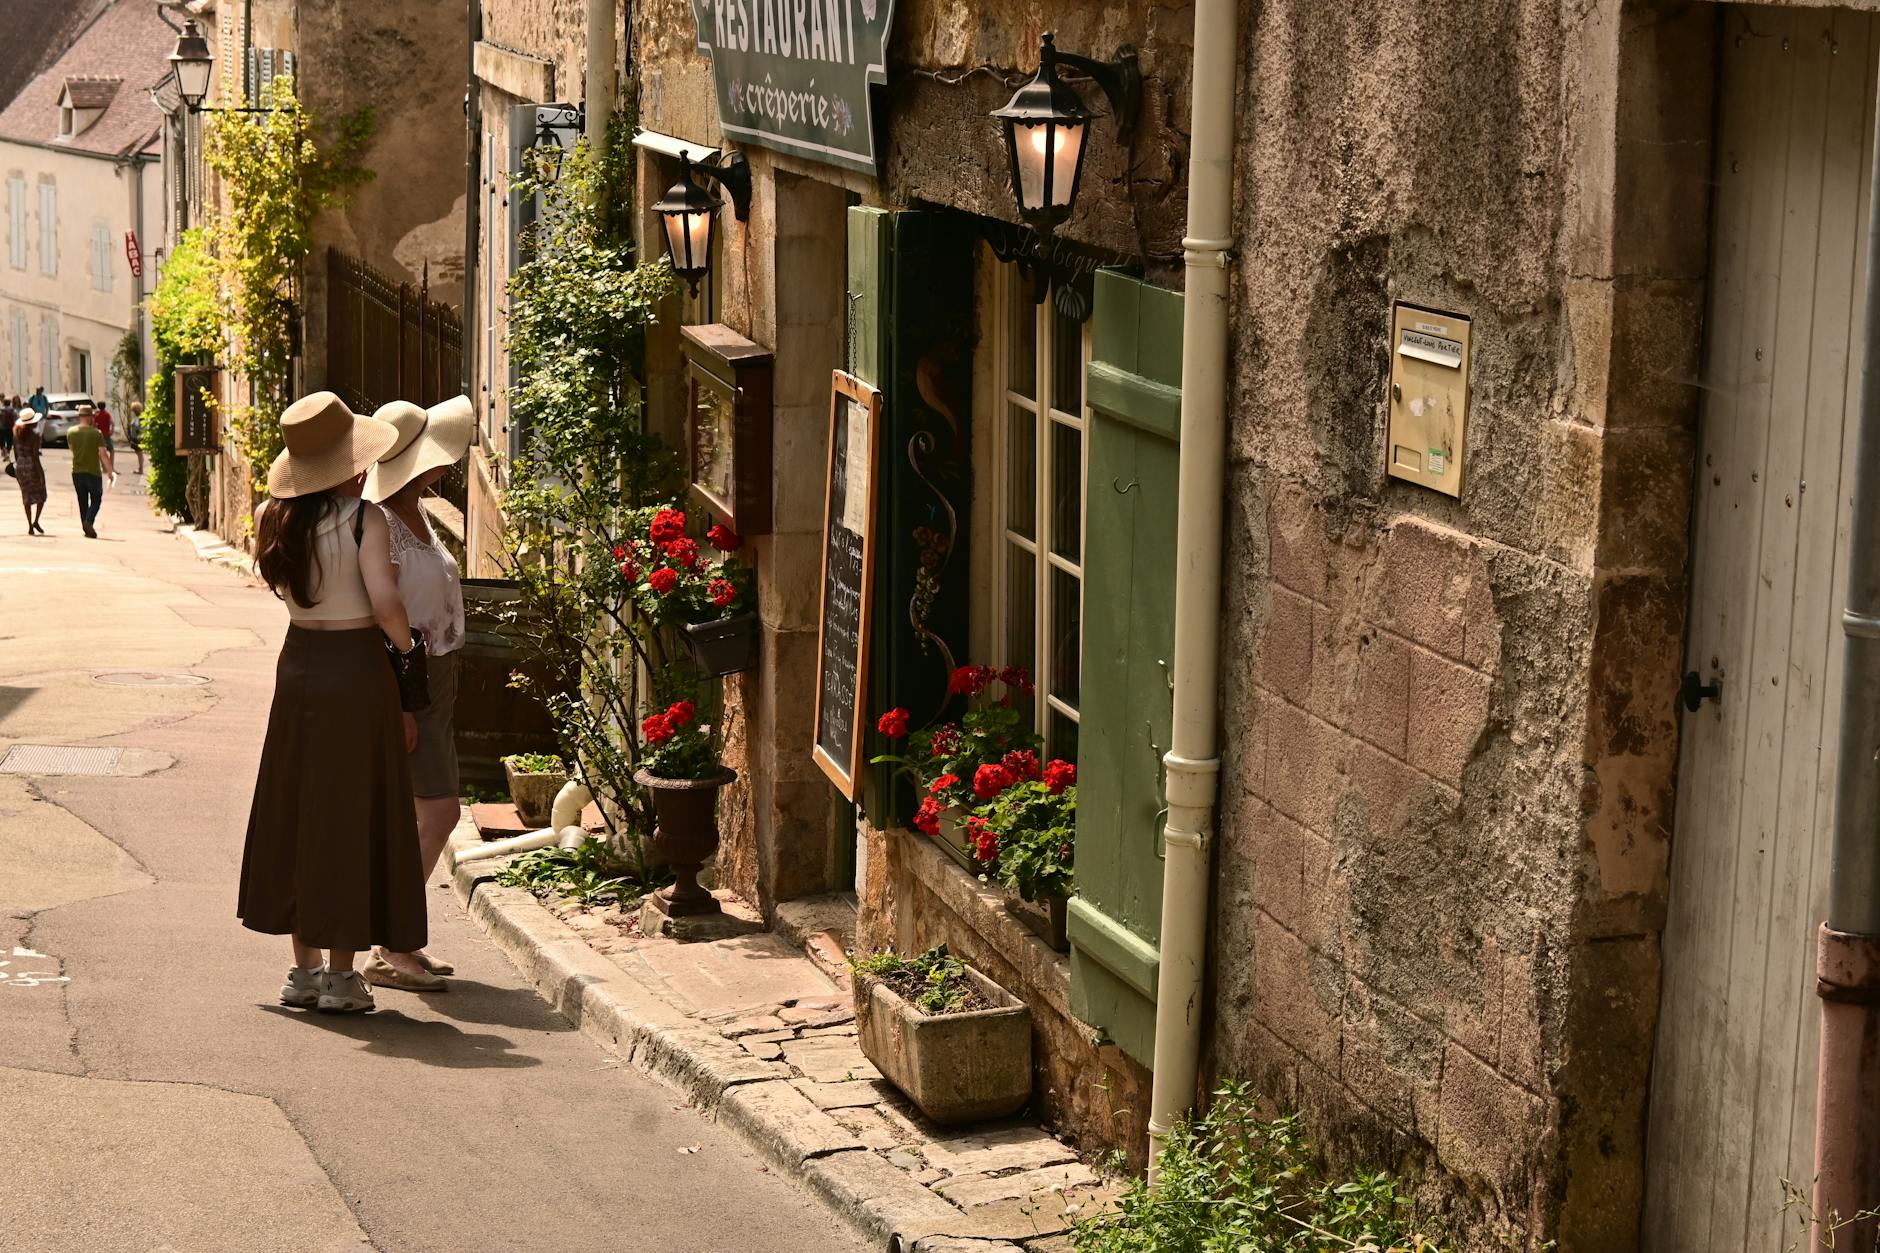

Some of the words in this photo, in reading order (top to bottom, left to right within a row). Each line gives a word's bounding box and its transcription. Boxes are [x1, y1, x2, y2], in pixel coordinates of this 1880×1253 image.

[714, 0, 855, 64] RESTAURANT
[746, 72, 830, 131] crêperie
[126, 231, 141, 276] TABAC
